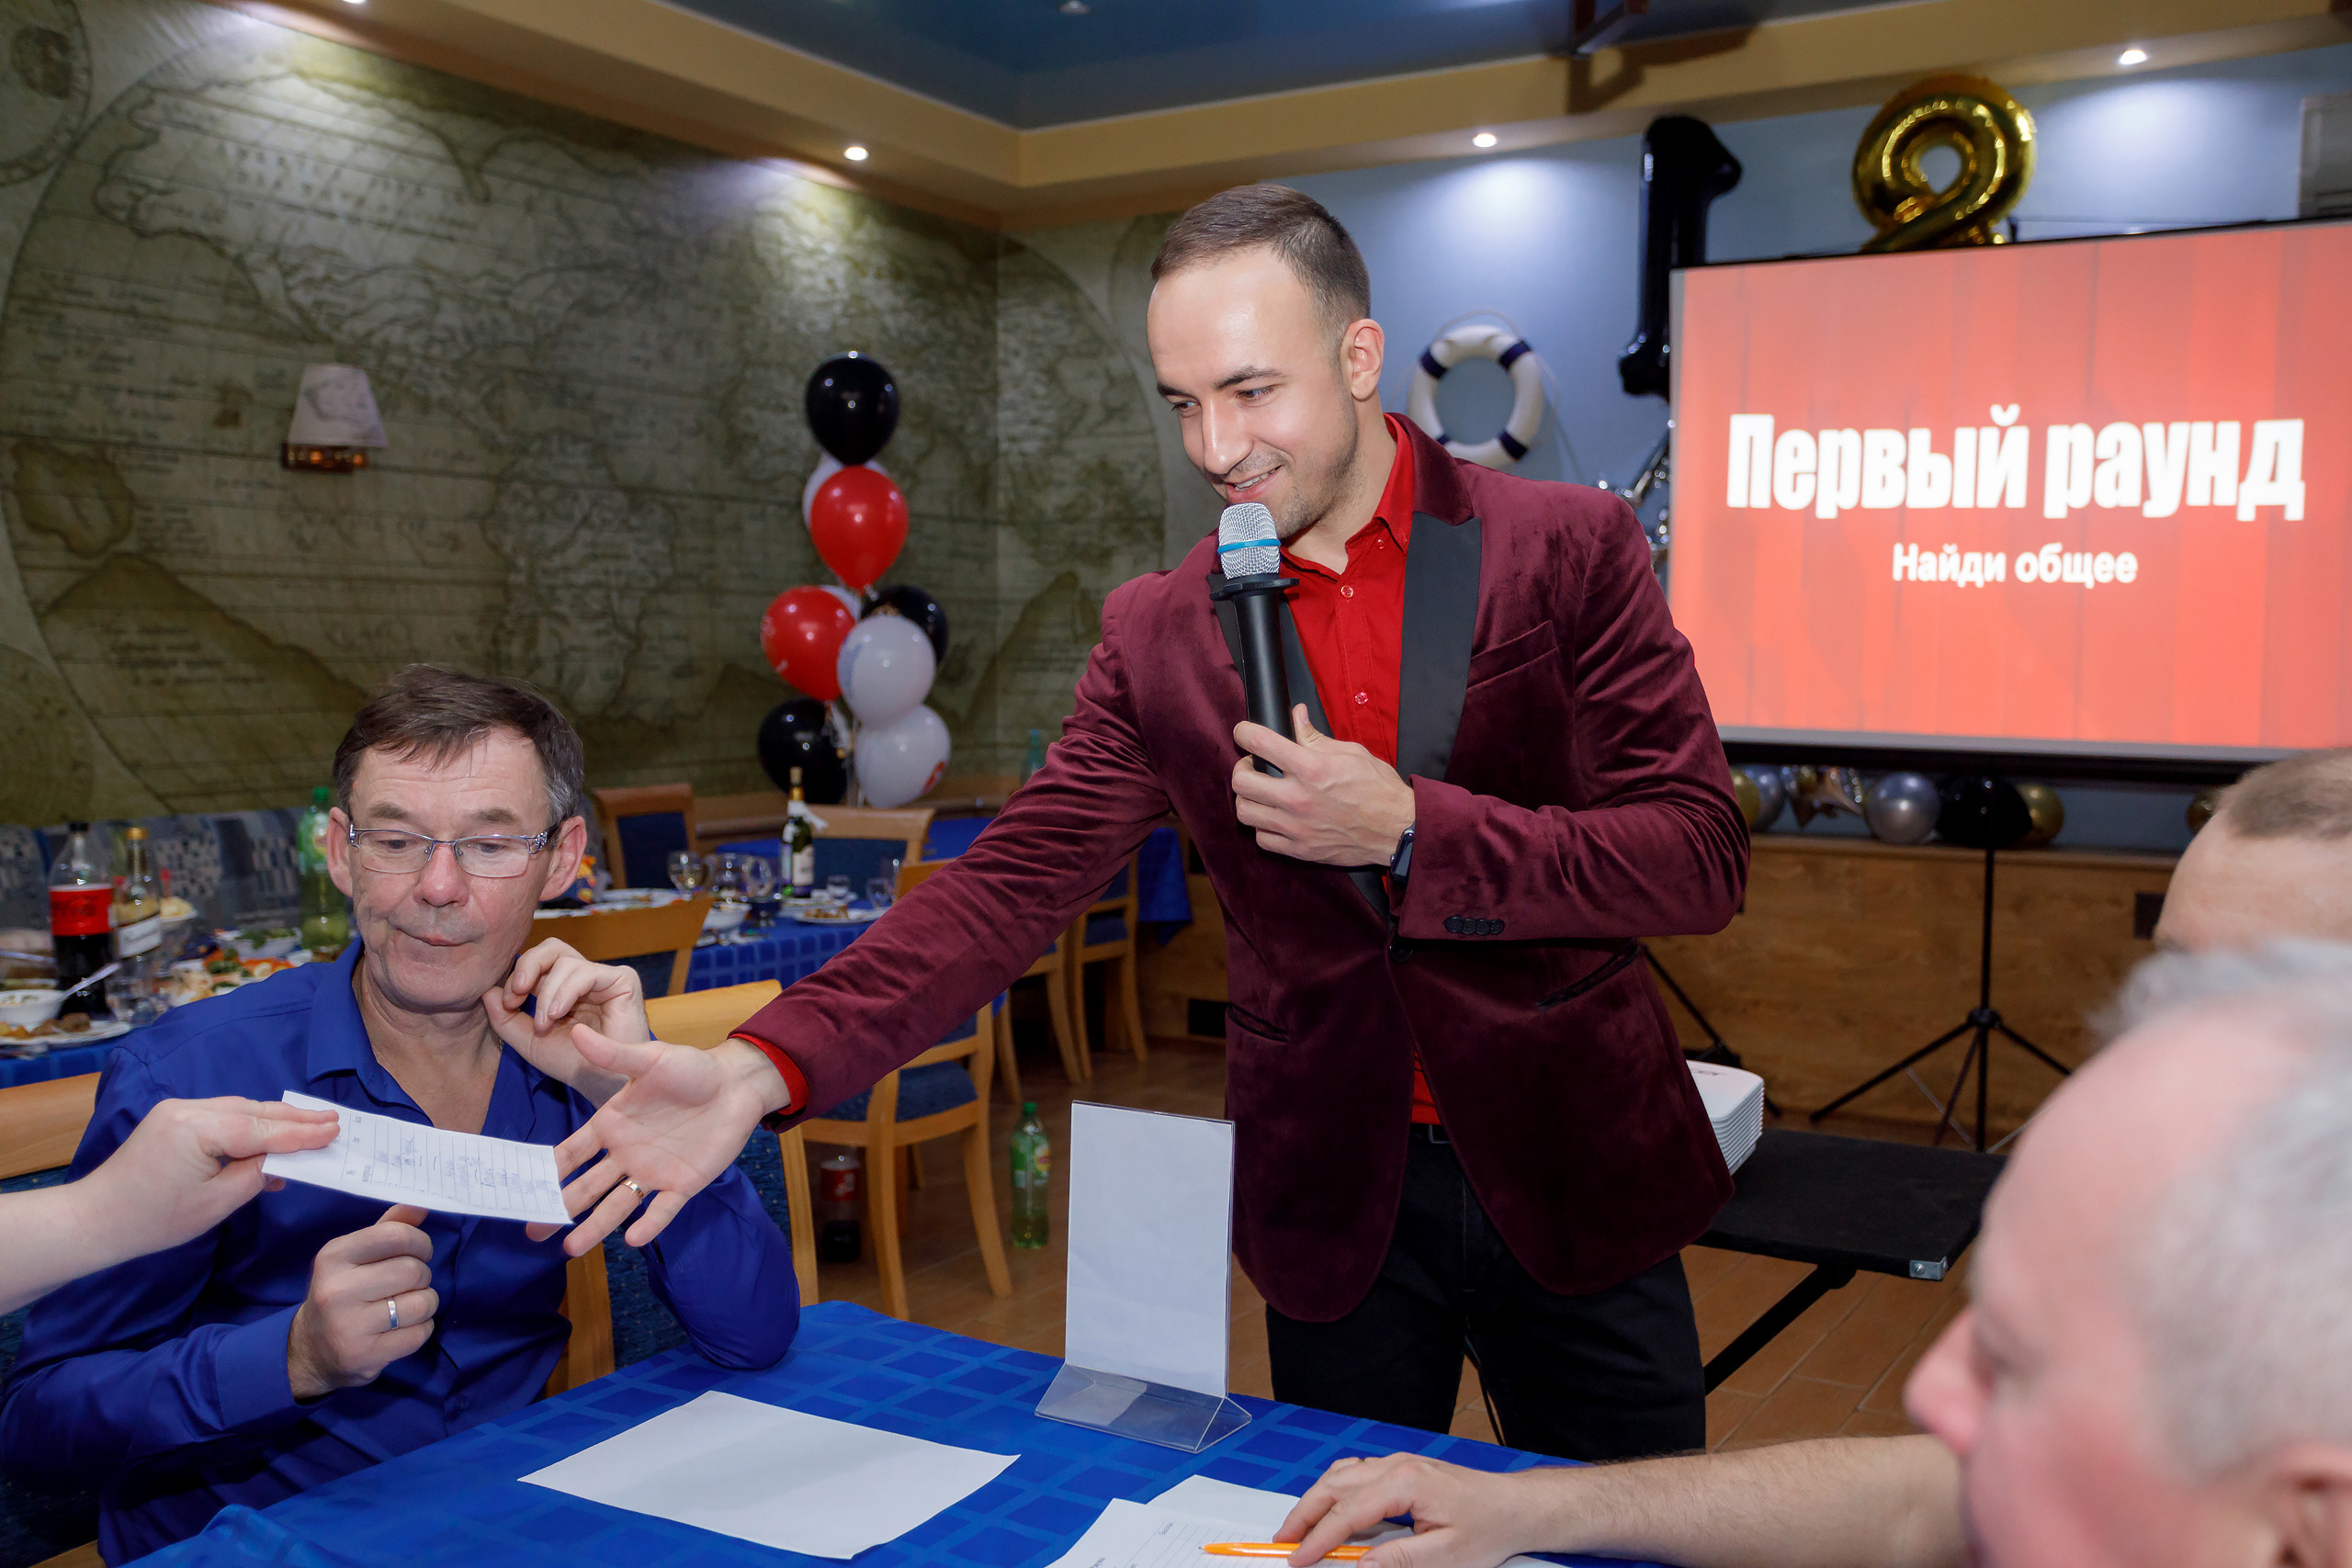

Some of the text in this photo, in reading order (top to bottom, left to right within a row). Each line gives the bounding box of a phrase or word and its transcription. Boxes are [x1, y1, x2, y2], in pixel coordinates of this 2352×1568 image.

[1727, 403, 2306, 523] Первый раунд
[1892, 542, 2139, 590] Найди общее
